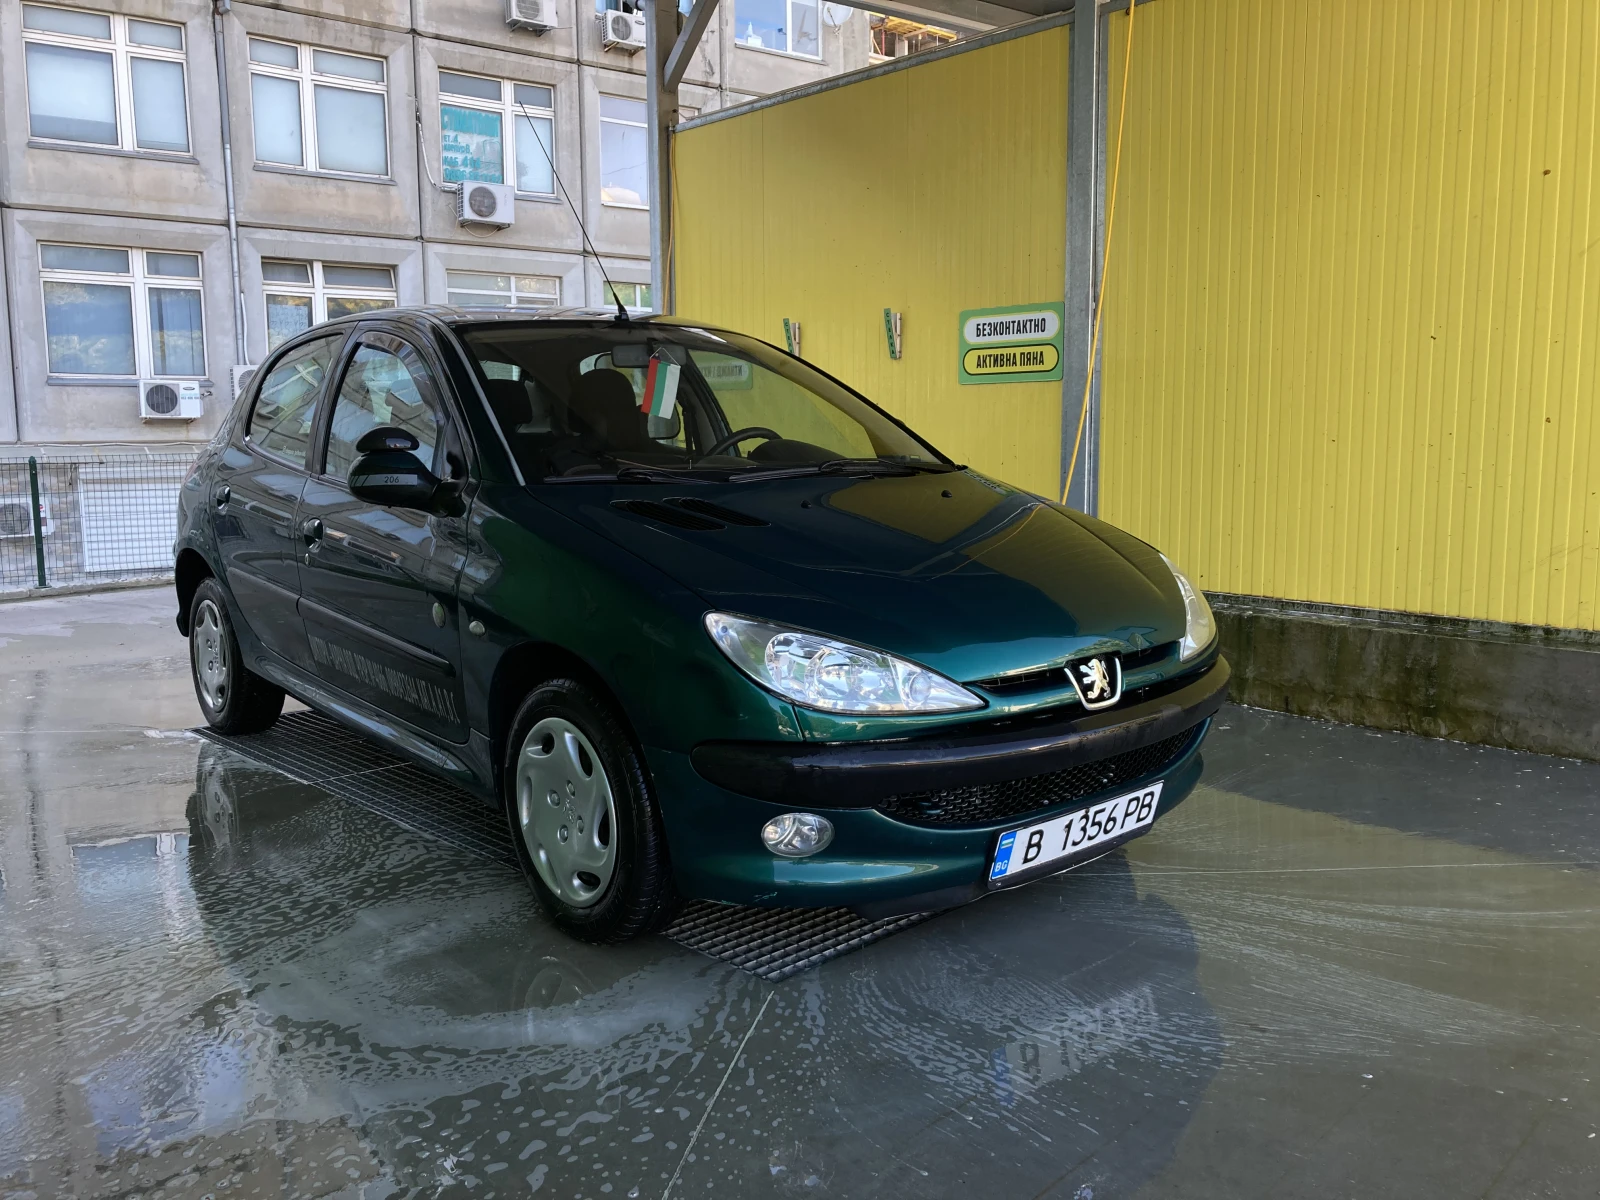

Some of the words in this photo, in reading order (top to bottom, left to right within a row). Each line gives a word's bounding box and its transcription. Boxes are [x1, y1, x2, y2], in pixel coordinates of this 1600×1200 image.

[975, 317, 1046, 338] БЕЗКОНТАКТНО
[976, 352, 1017, 369] АКТИВНА
[1019, 351, 1044, 366] ПЯНА
[384, 475, 400, 484] 206
[994, 859, 1009, 872] BG
[1022, 829, 1045, 865] B
[1062, 802, 1119, 851] 1356
[1119, 790, 1155, 830] PB
